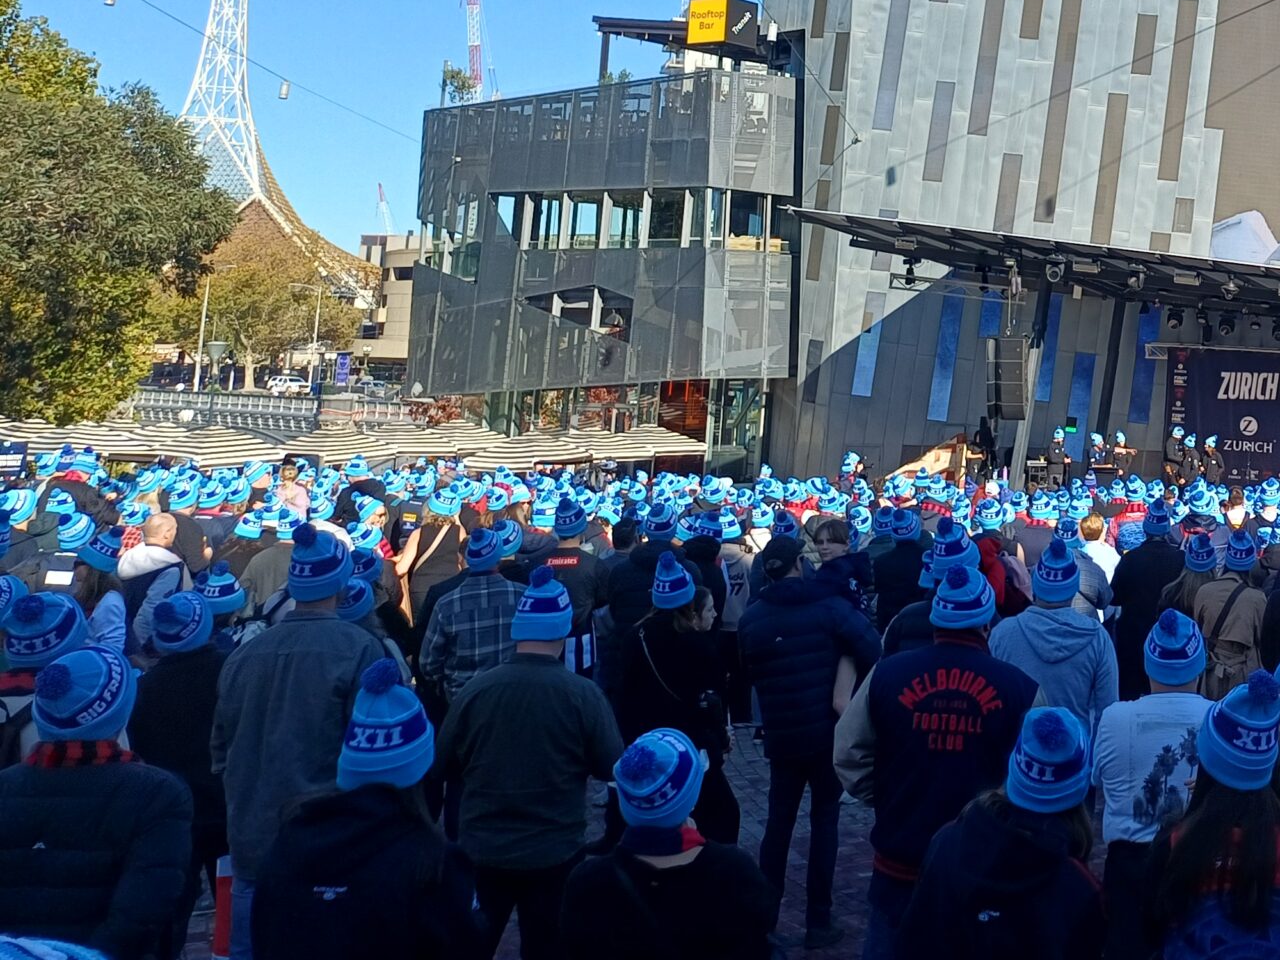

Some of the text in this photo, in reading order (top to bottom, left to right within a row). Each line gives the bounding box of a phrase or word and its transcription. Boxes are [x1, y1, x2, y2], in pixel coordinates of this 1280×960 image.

[691, 10, 725, 20] Rooftop
[731, 11, 752, 35] Transit
[699, 21, 715, 30] Bar
[1217, 372, 1279, 400] ZURICH
[1223, 440, 1273, 453] ZURICH
[92, 541, 114, 555] XII
[1228, 549, 1246, 558] XII
[547, 557, 577, 565] Emirates
[1038, 565, 1064, 581] XII
[9, 630, 61, 654] XII
[898, 668, 1003, 715] MELBOURNE
[76, 700, 106, 726] BIG
[912, 712, 983, 734] FOOTBALL
[349, 726, 405, 748] XII
[928, 734, 964, 751] CLUB
